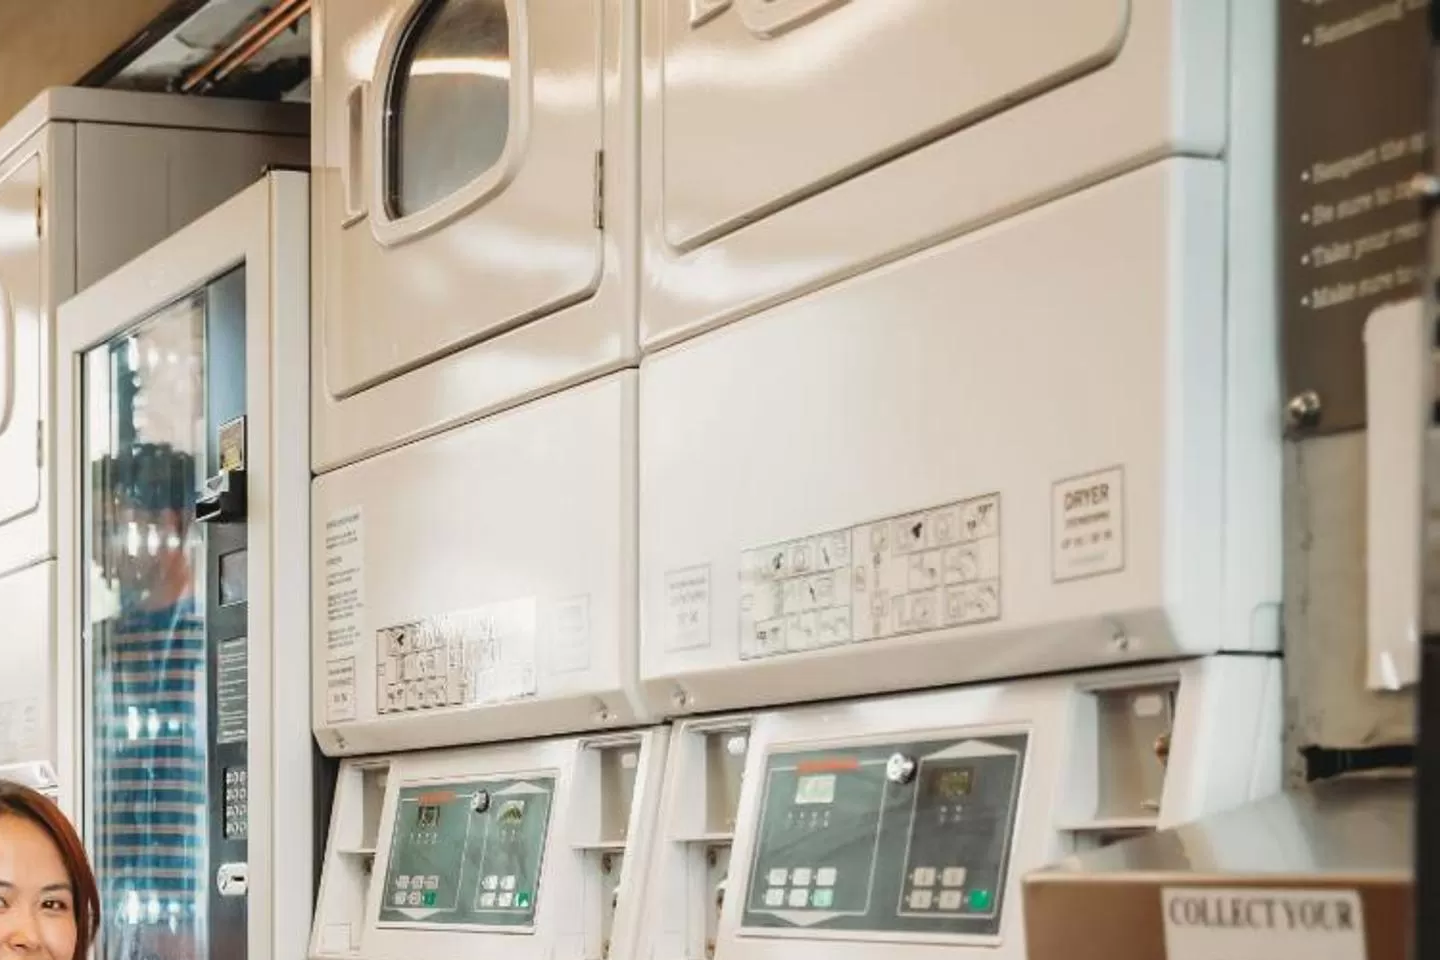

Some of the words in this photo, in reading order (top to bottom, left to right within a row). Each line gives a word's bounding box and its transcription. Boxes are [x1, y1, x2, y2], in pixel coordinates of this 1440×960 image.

[1064, 484, 1109, 511] DRYER
[1169, 896, 1275, 928] COLLECT
[1279, 898, 1354, 931] YOUR
